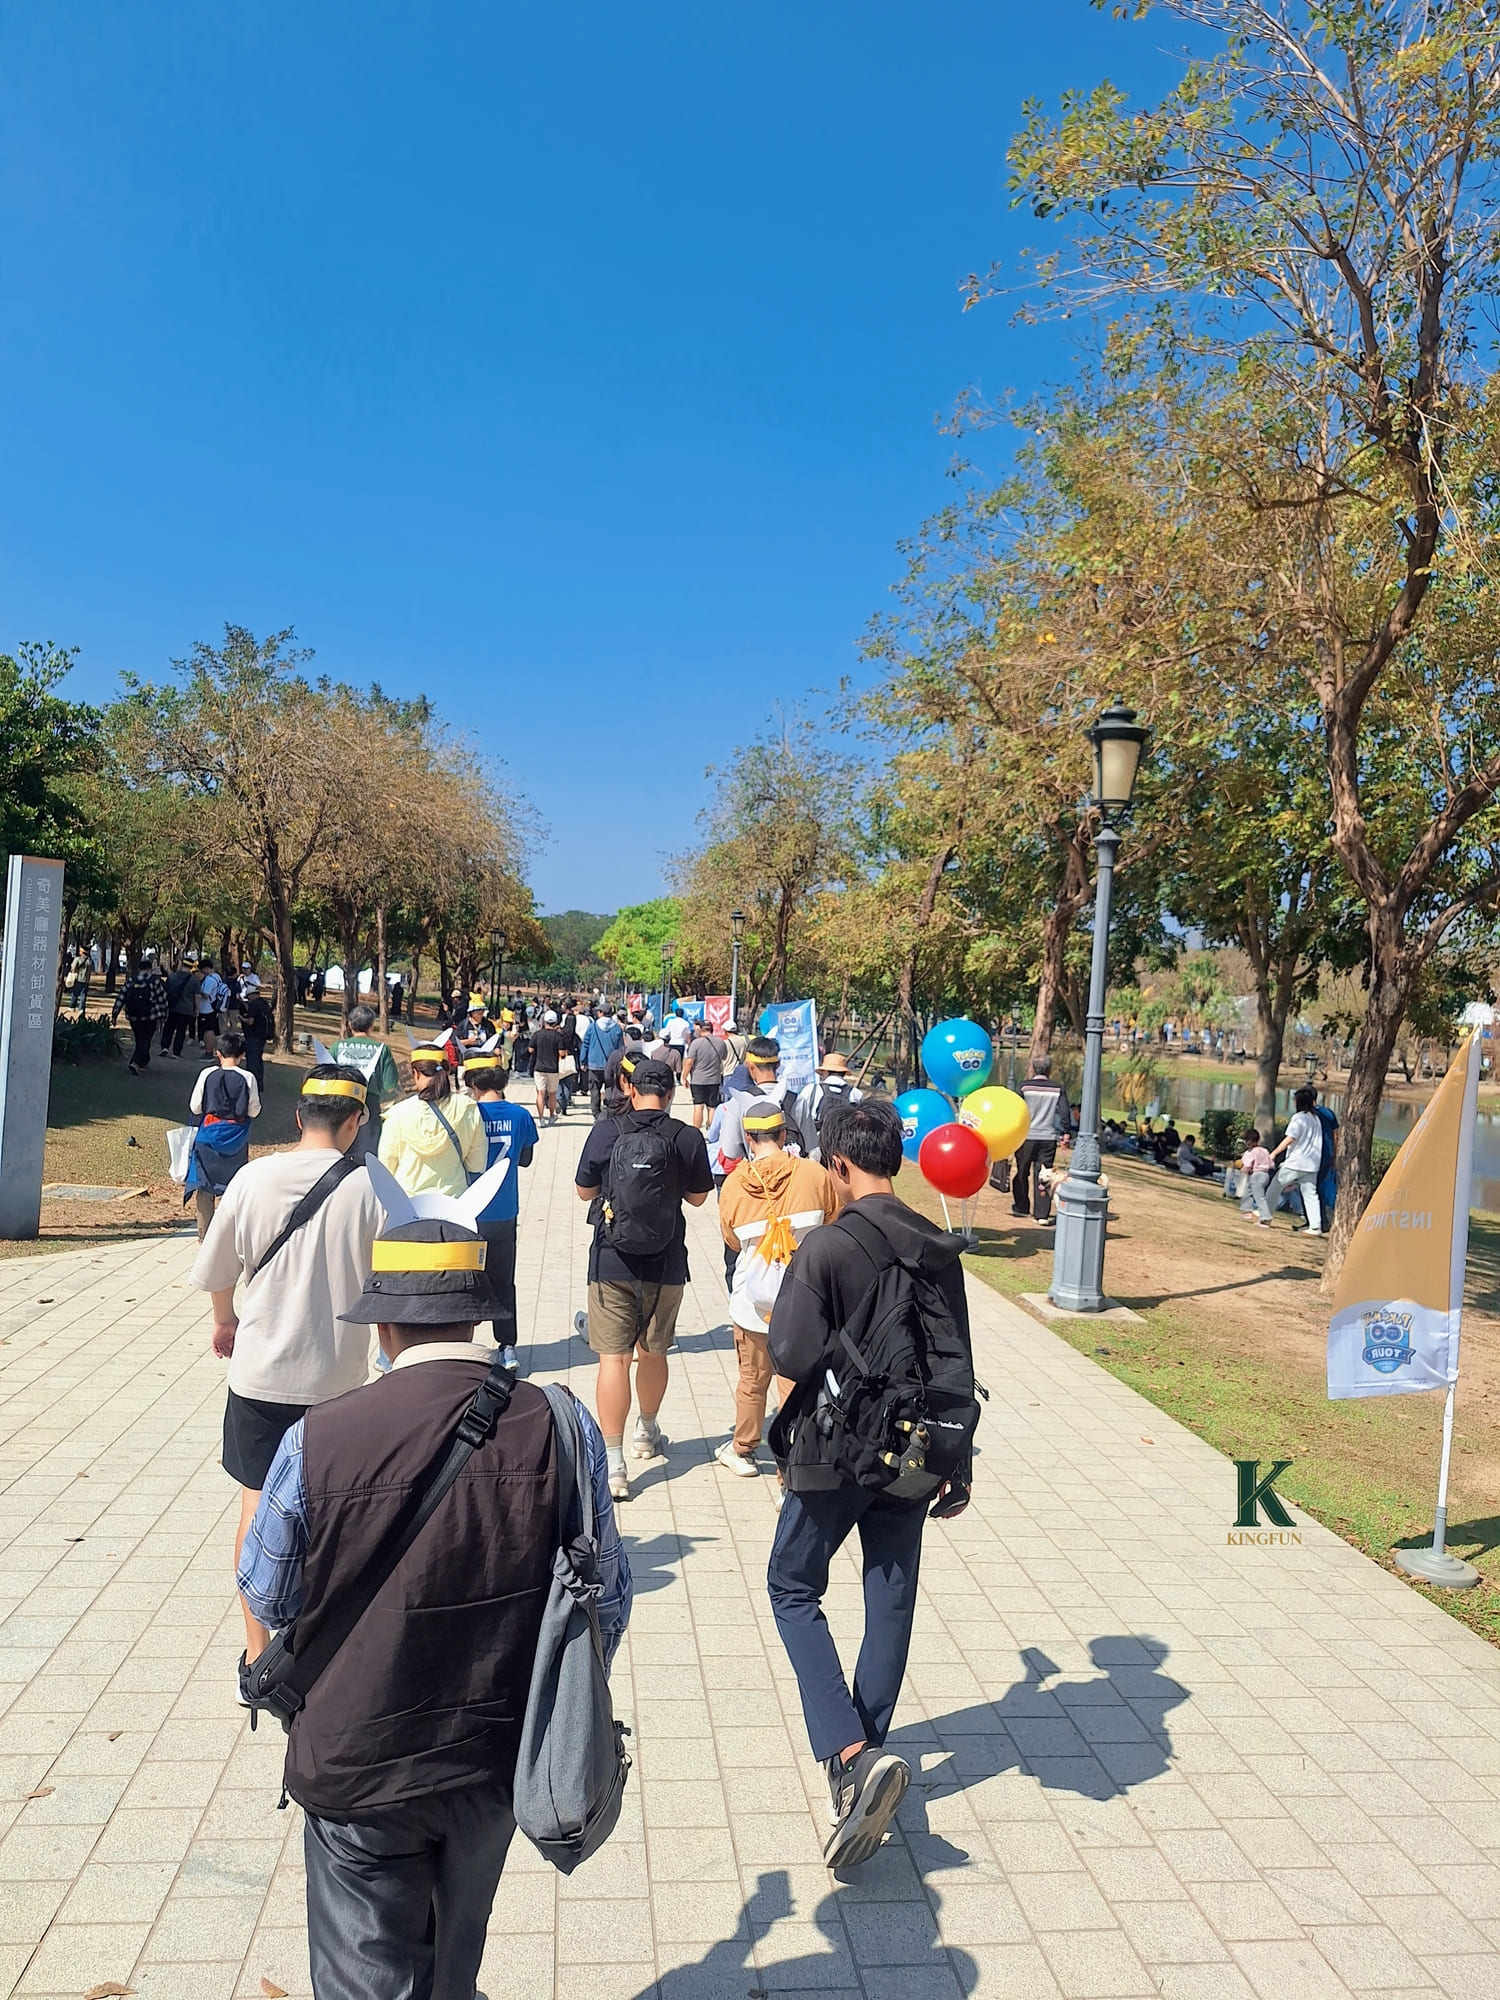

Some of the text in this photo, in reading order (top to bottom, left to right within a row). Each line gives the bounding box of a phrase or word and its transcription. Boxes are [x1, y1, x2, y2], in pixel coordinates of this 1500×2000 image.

[28, 877, 51, 1029] 奇美廳器材卸貨區
[961, 1060, 981, 1070] GO
[485, 1120, 512, 1132] HTANI
[486, 1135, 512, 1165] 7
